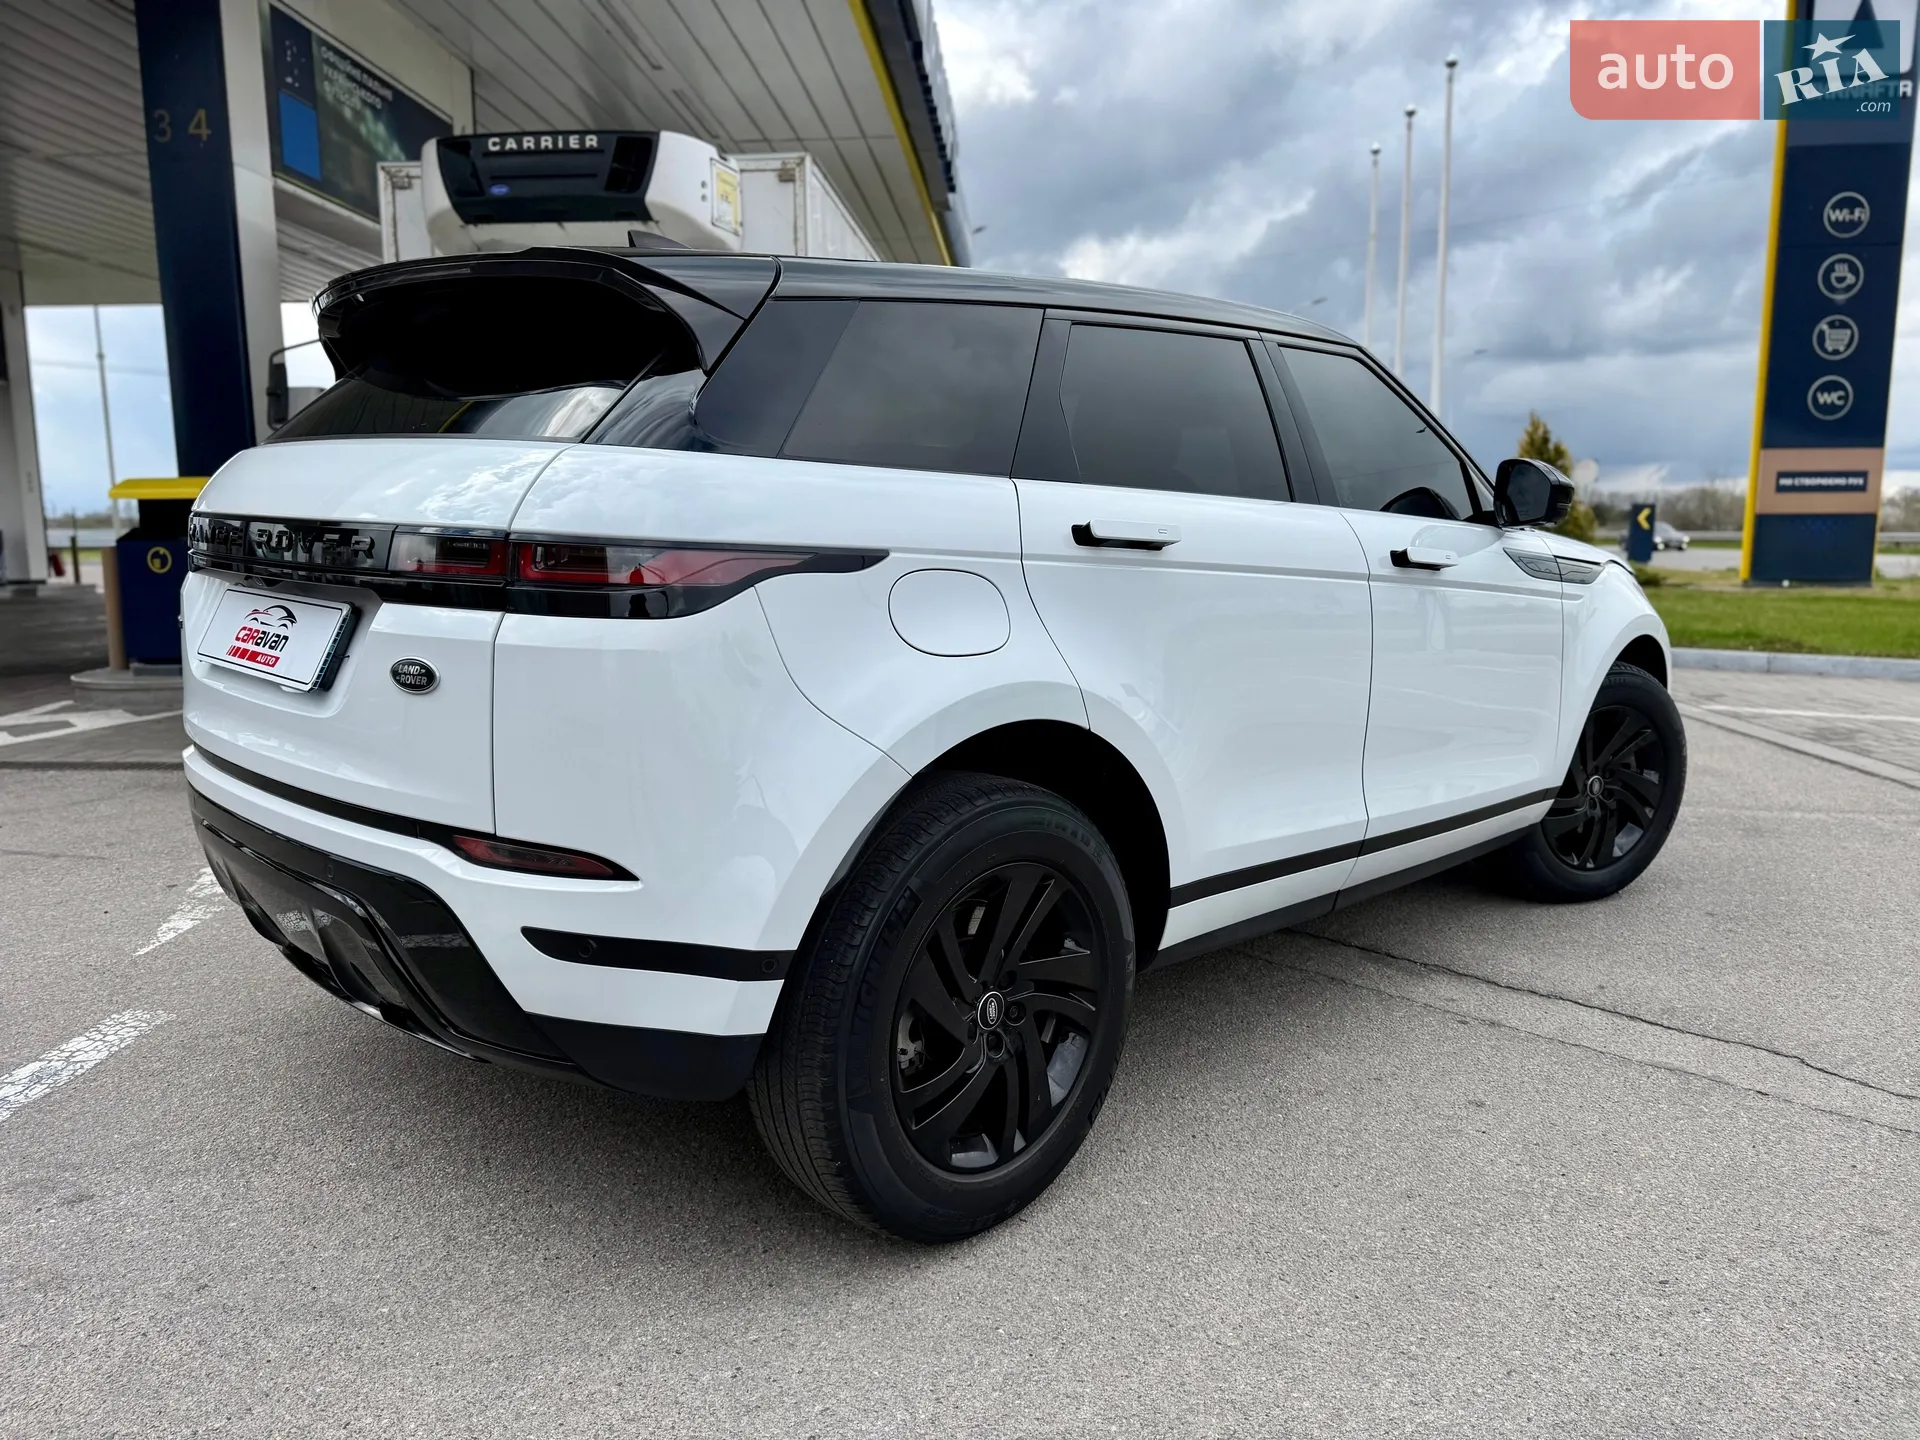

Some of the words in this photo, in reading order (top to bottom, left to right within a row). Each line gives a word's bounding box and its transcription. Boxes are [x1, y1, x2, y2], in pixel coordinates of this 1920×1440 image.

[153, 109, 172, 143] 3
[188, 108, 211, 142] 4
[487, 134, 599, 152] CARRIER
[1829, 206, 1866, 222] Wi-Fi
[1816, 390, 1846, 406] WC
[256, 528, 376, 560] ROVER
[255, 653, 277, 666] AUTO
[398, 664, 421, 675] LAND
[400, 674, 428, 686] ROVER
